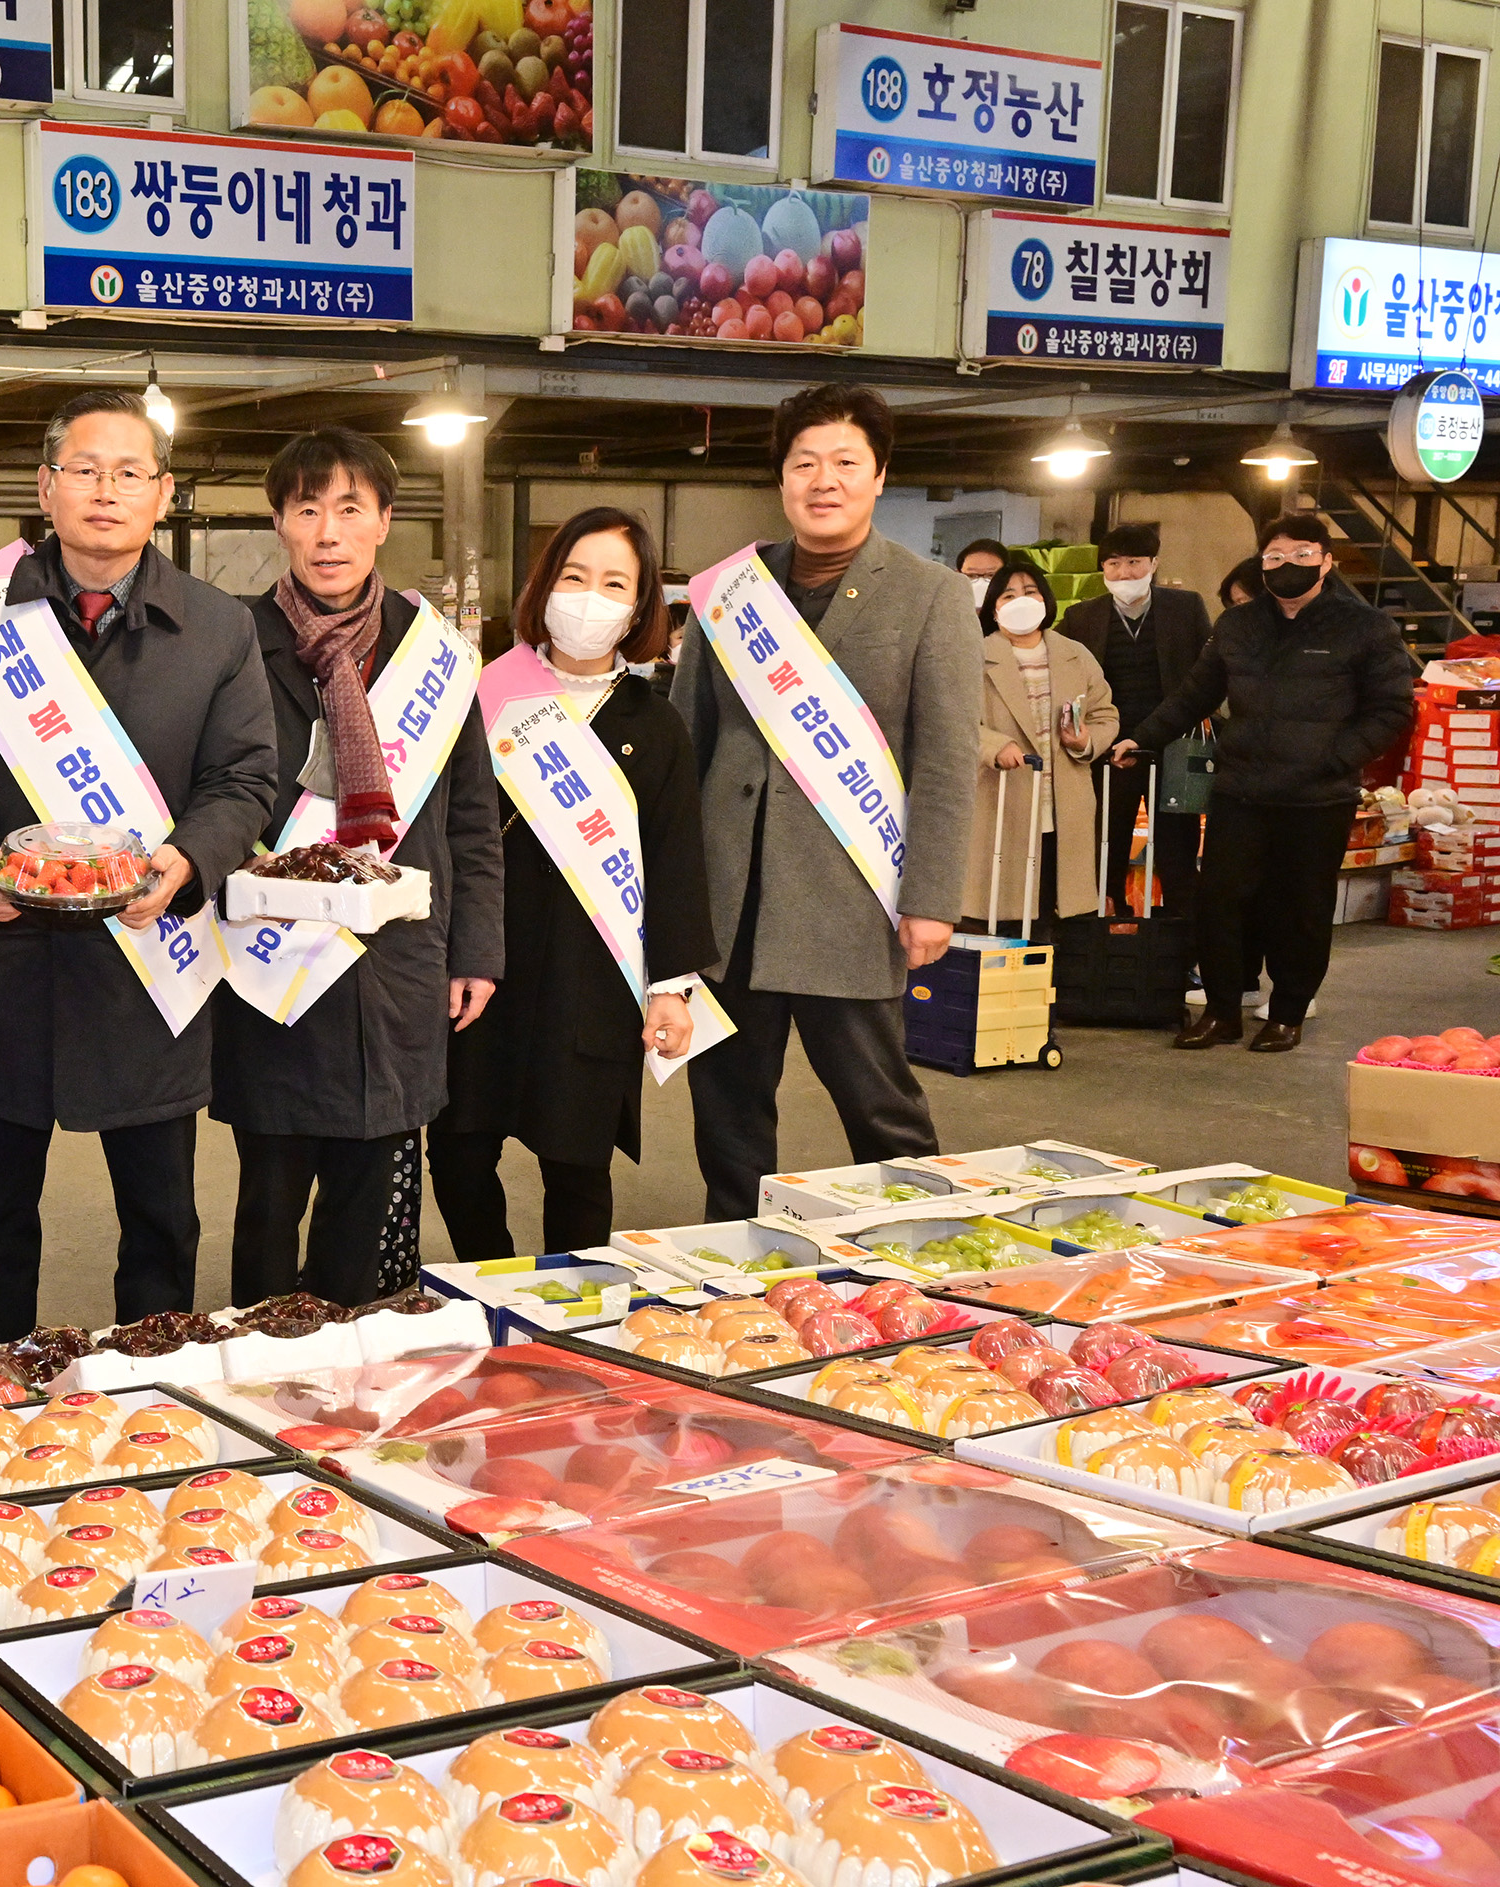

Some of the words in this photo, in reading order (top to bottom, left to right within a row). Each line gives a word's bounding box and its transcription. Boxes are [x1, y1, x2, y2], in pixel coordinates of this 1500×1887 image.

[866, 67, 902, 111] 188
[917, 62, 1084, 143] 호정농산
[60, 169, 113, 219] 183
[898, 151, 1068, 197] 울산중앙청과시장(주)
[135, 268, 375, 313] 울산중앙청과시장(주)
[1021, 250, 1045, 289] 78
[1065, 240, 1212, 309] 칠칠상회
[1384, 272, 1500, 344] 울산중앙
[1045, 327, 1198, 360] 울산중앙청과시장(주)
[1328, 358, 1348, 385] 2F
[1436, 415, 1481, 440] 호정농산
[397, 639, 458, 742] 계묘년
[734, 602, 780, 665] 새해
[767, 660, 804, 695] 복
[790, 695, 851, 760] 많이
[510, 701, 560, 737] 울산광역시
[28, 699, 73, 743] 복
[56, 746, 125, 826] 많이
[532, 740, 592, 809] 새해
[576, 808, 616, 846] 복
[601, 848, 644, 915] 많이
[257, 1694, 292, 1711] 名品
